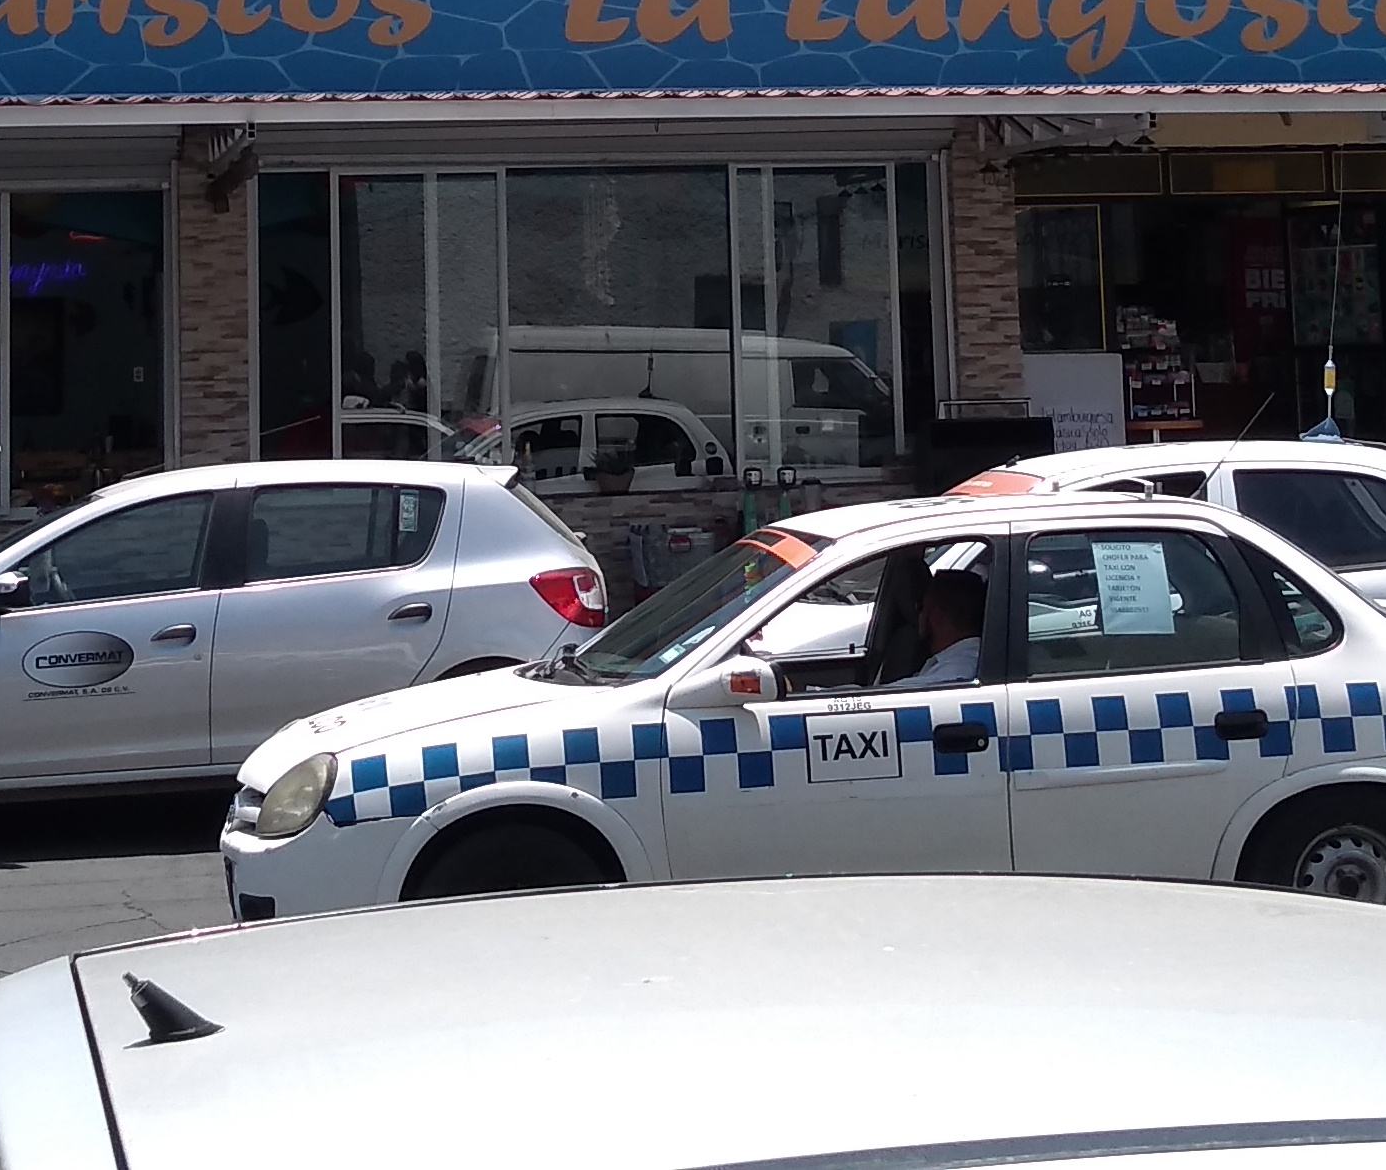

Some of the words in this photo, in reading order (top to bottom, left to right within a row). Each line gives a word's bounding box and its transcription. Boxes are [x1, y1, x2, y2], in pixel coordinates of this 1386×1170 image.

[35, 650, 124, 669] CONVERMAT
[827, 702, 872, 712] 9312JEG
[813, 730, 889, 762] TAXI
